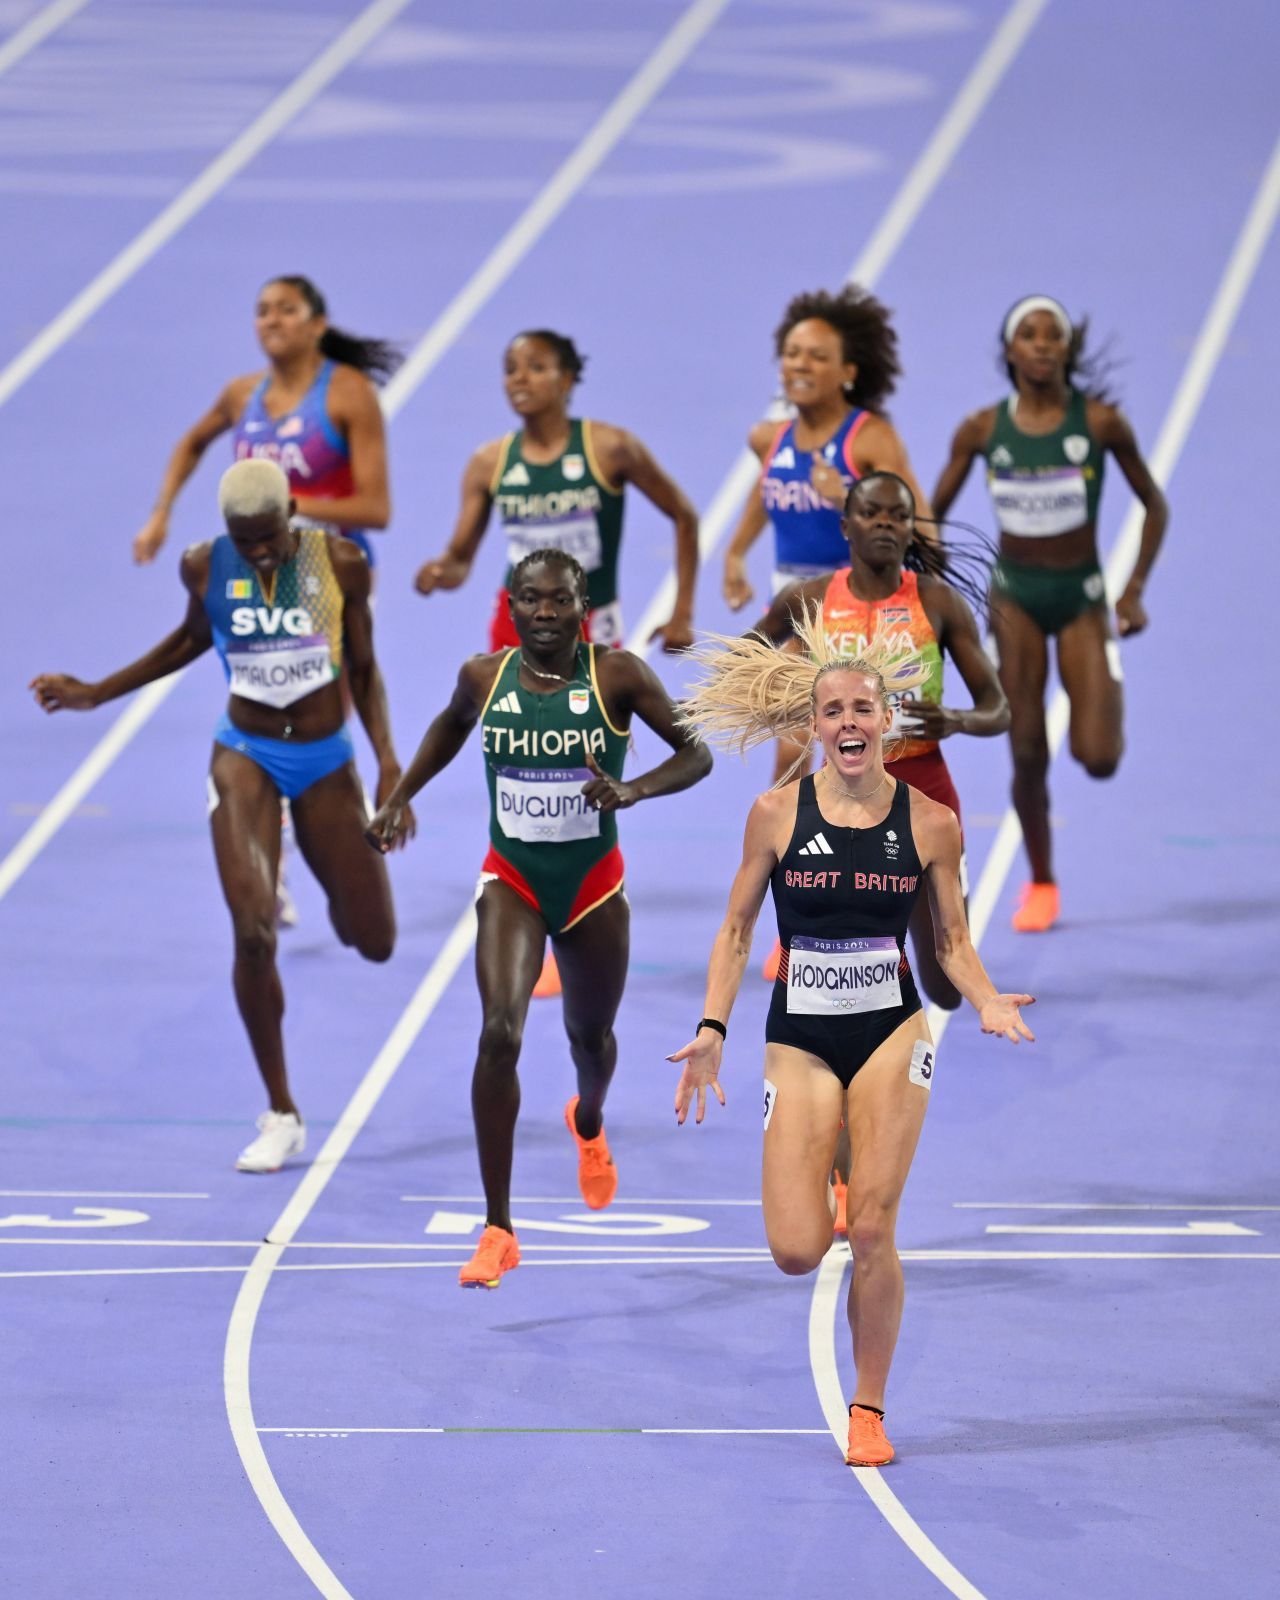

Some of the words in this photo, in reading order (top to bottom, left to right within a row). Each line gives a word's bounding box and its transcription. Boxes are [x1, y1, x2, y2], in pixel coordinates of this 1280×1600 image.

[231, 606, 312, 636] SVG
[235, 656, 324, 687] MALONEY
[482, 725, 606, 756] ETHIOPIA
[518, 771, 545, 779] PARIS
[548, 771, 574, 779] 2024
[785, 869, 841, 888] GREAT
[854, 872, 918, 892] BRITAIN
[815, 941, 841, 950] PARIS
[845, 941, 869, 949] 2024
[790, 962, 897, 990] HODGKINSON
[920, 1052, 932, 1079] 5
[425, 1210, 710, 1236] 2
